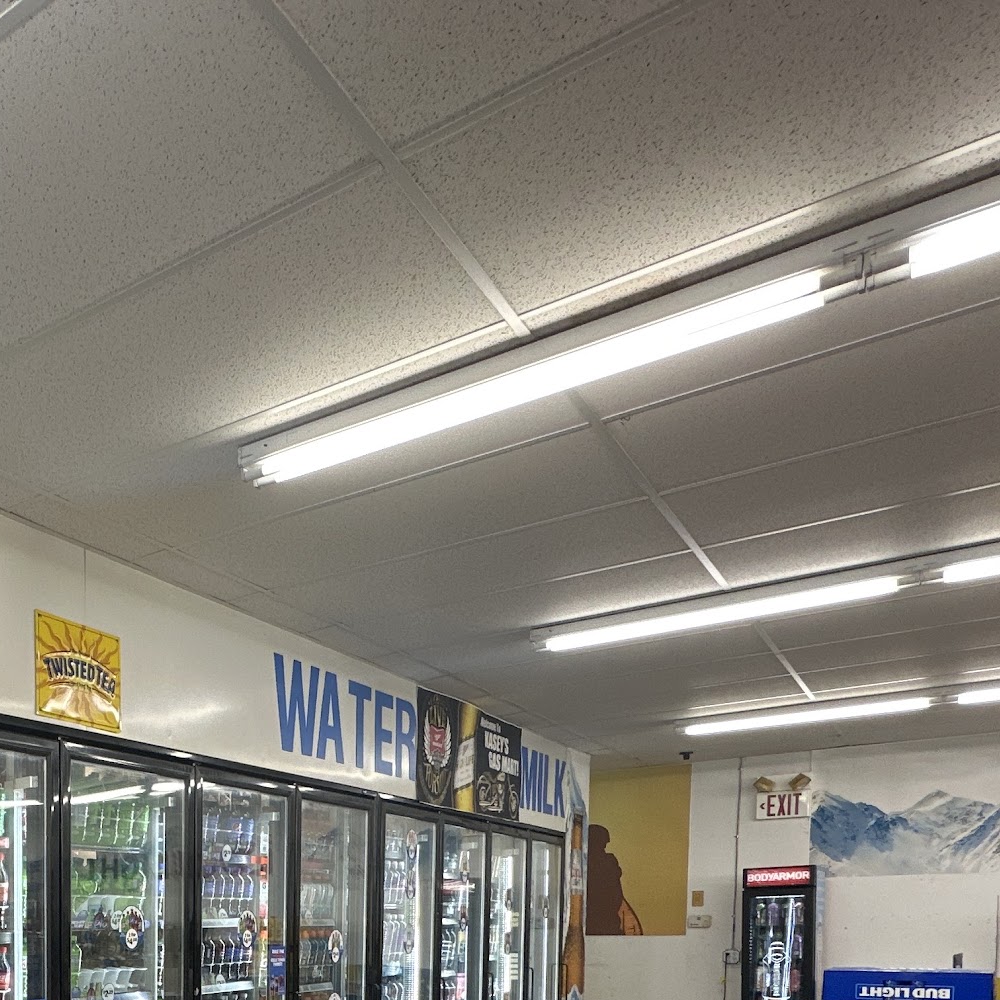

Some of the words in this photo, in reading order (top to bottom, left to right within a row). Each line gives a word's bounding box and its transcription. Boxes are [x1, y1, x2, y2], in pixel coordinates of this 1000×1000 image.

[43, 656, 95, 684] TWISTED
[95, 664, 116, 698] TEA
[273, 652, 417, 782] WATER
[484, 732, 509, 755] KASEY'S
[488, 751, 501, 771] GAS
[521, 745, 567, 819] MILK
[766, 793, 802, 817] EXIT
[747, 870, 810, 884] BODYARMOR
[858, 986, 909, 998] LIGHT
[912, 988, 951, 999] BUD
